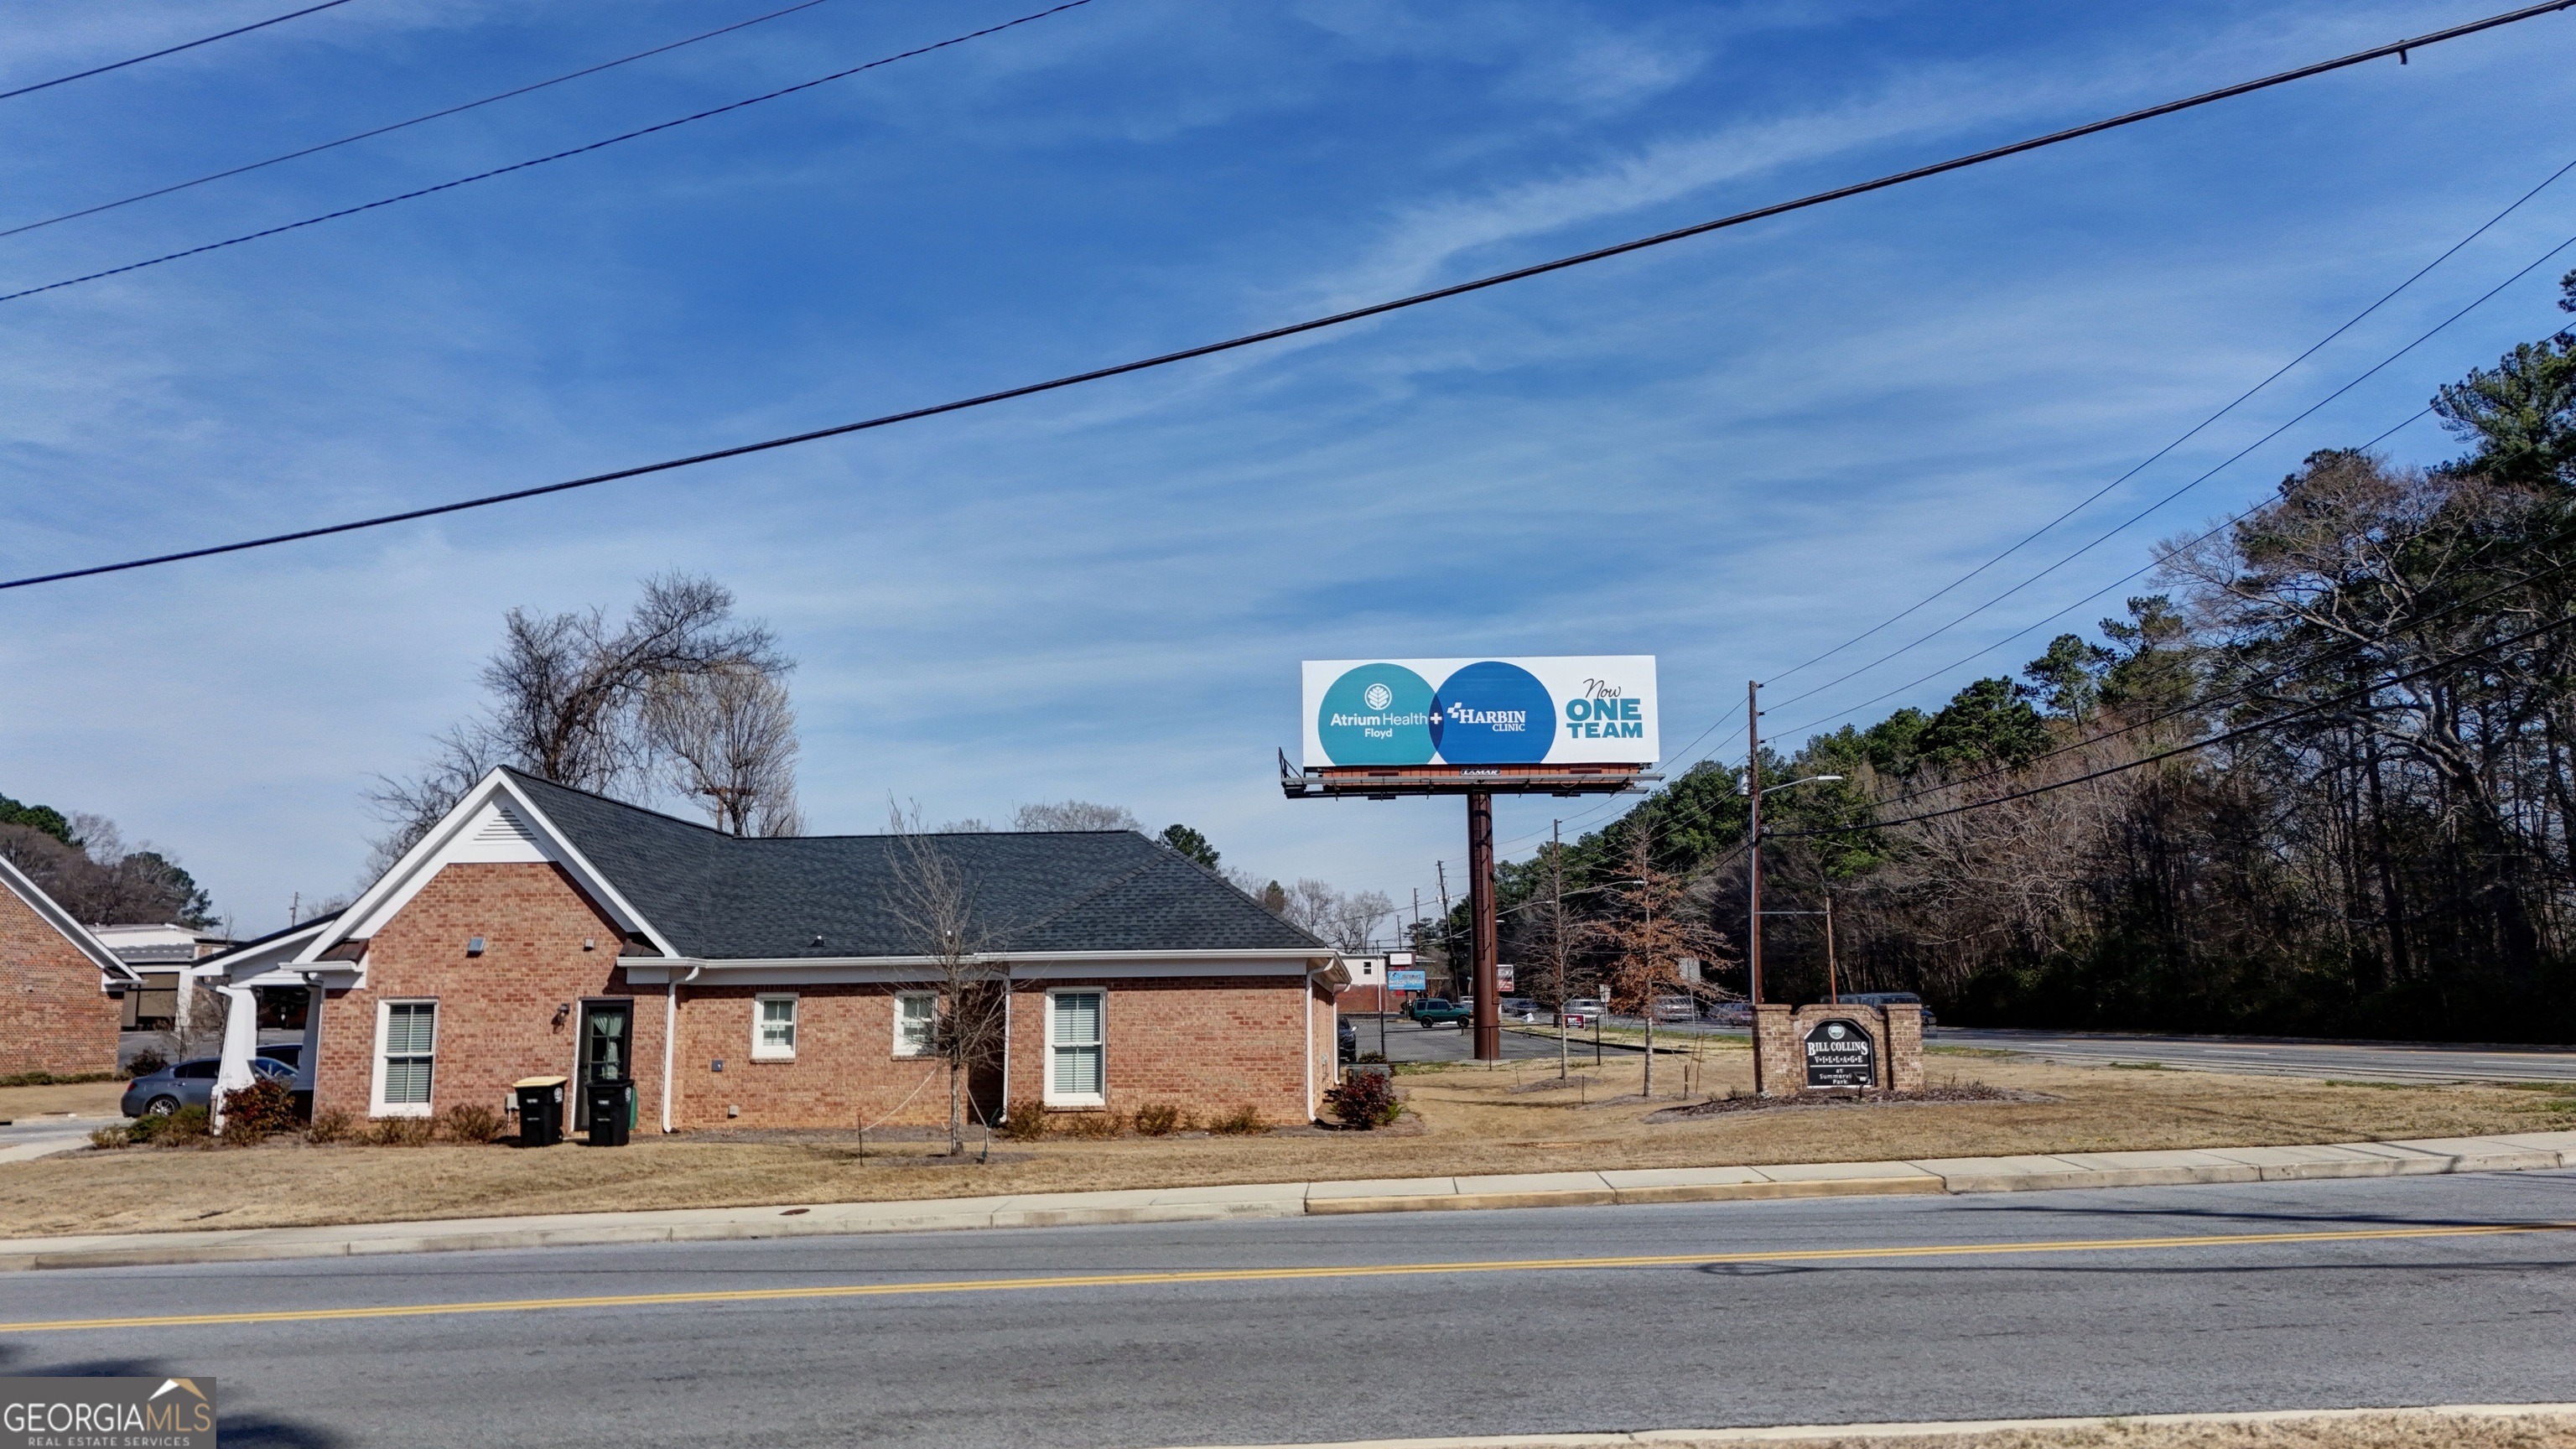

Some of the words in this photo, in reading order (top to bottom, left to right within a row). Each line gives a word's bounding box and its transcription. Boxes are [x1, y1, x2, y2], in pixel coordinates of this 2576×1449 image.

[1582, 678, 1622, 701] Now
[1459, 709, 1526, 724] HARBIN
[1566, 698, 1642, 722] ONE
[1330, 713, 1380, 726] Atrium
[1382, 712, 1428, 725] Health
[1364, 728, 1393, 740] Floyd
[1492, 724, 1525, 732] CLINIC
[1566, 722, 1644, 739] TEAM
[1807, 1041, 1830, 1056] BILL
[1830, 1041, 1869, 1056] COLLINS
